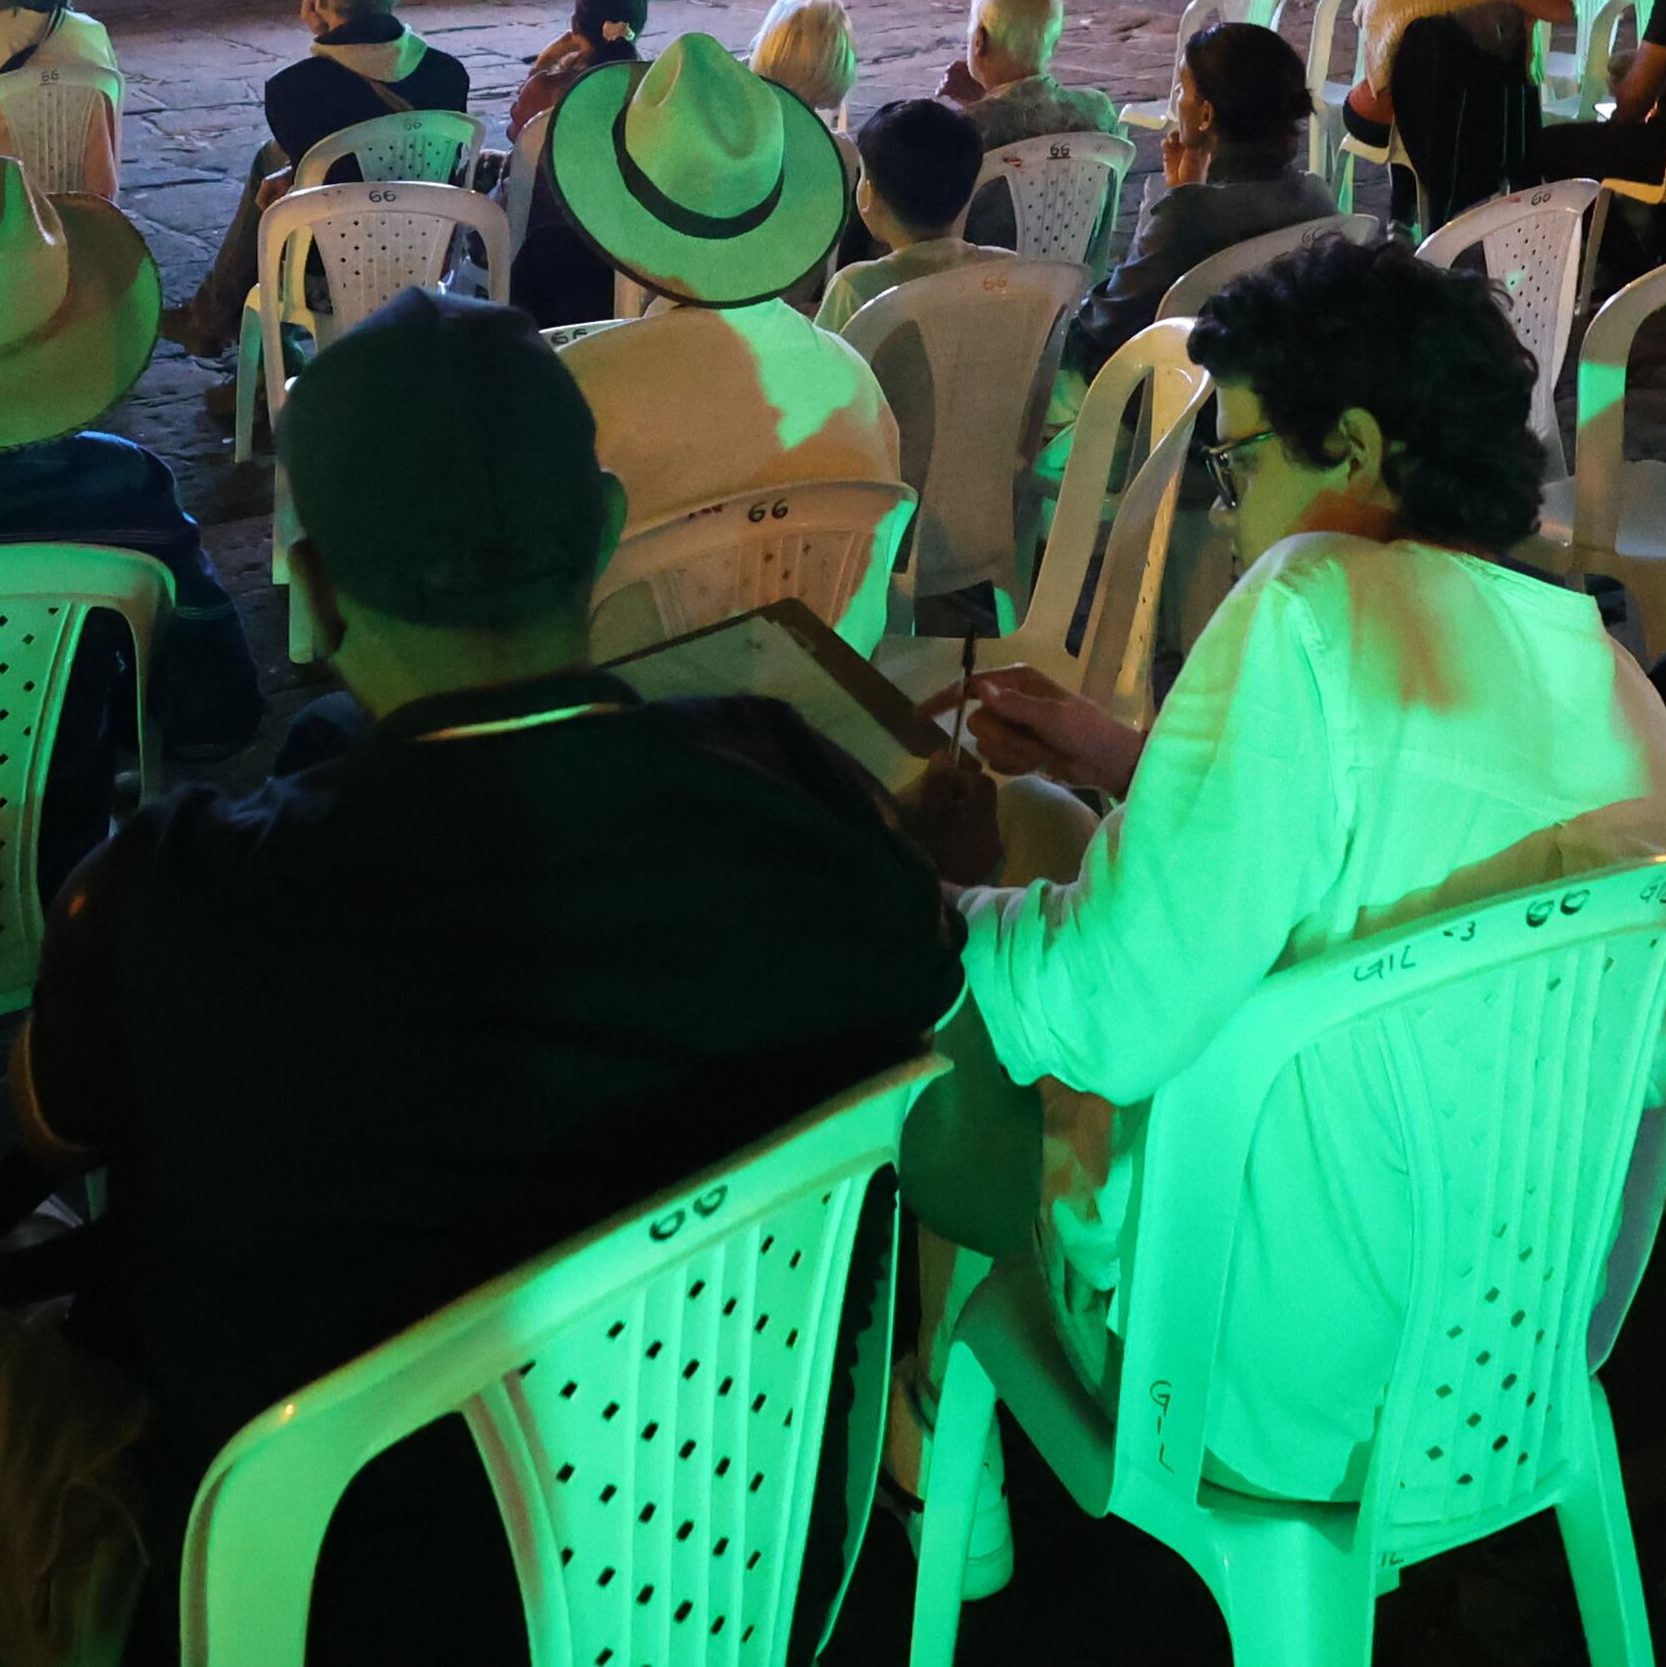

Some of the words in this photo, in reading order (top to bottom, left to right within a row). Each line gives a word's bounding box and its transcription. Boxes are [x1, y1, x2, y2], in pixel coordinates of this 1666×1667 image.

[1050, 142, 1071, 158] 66
[368, 190, 397, 203] 66
[748, 497, 789, 523] 66
[1354, 945, 1417, 982] GIL
[1149, 1380, 1175, 1475] GIL
